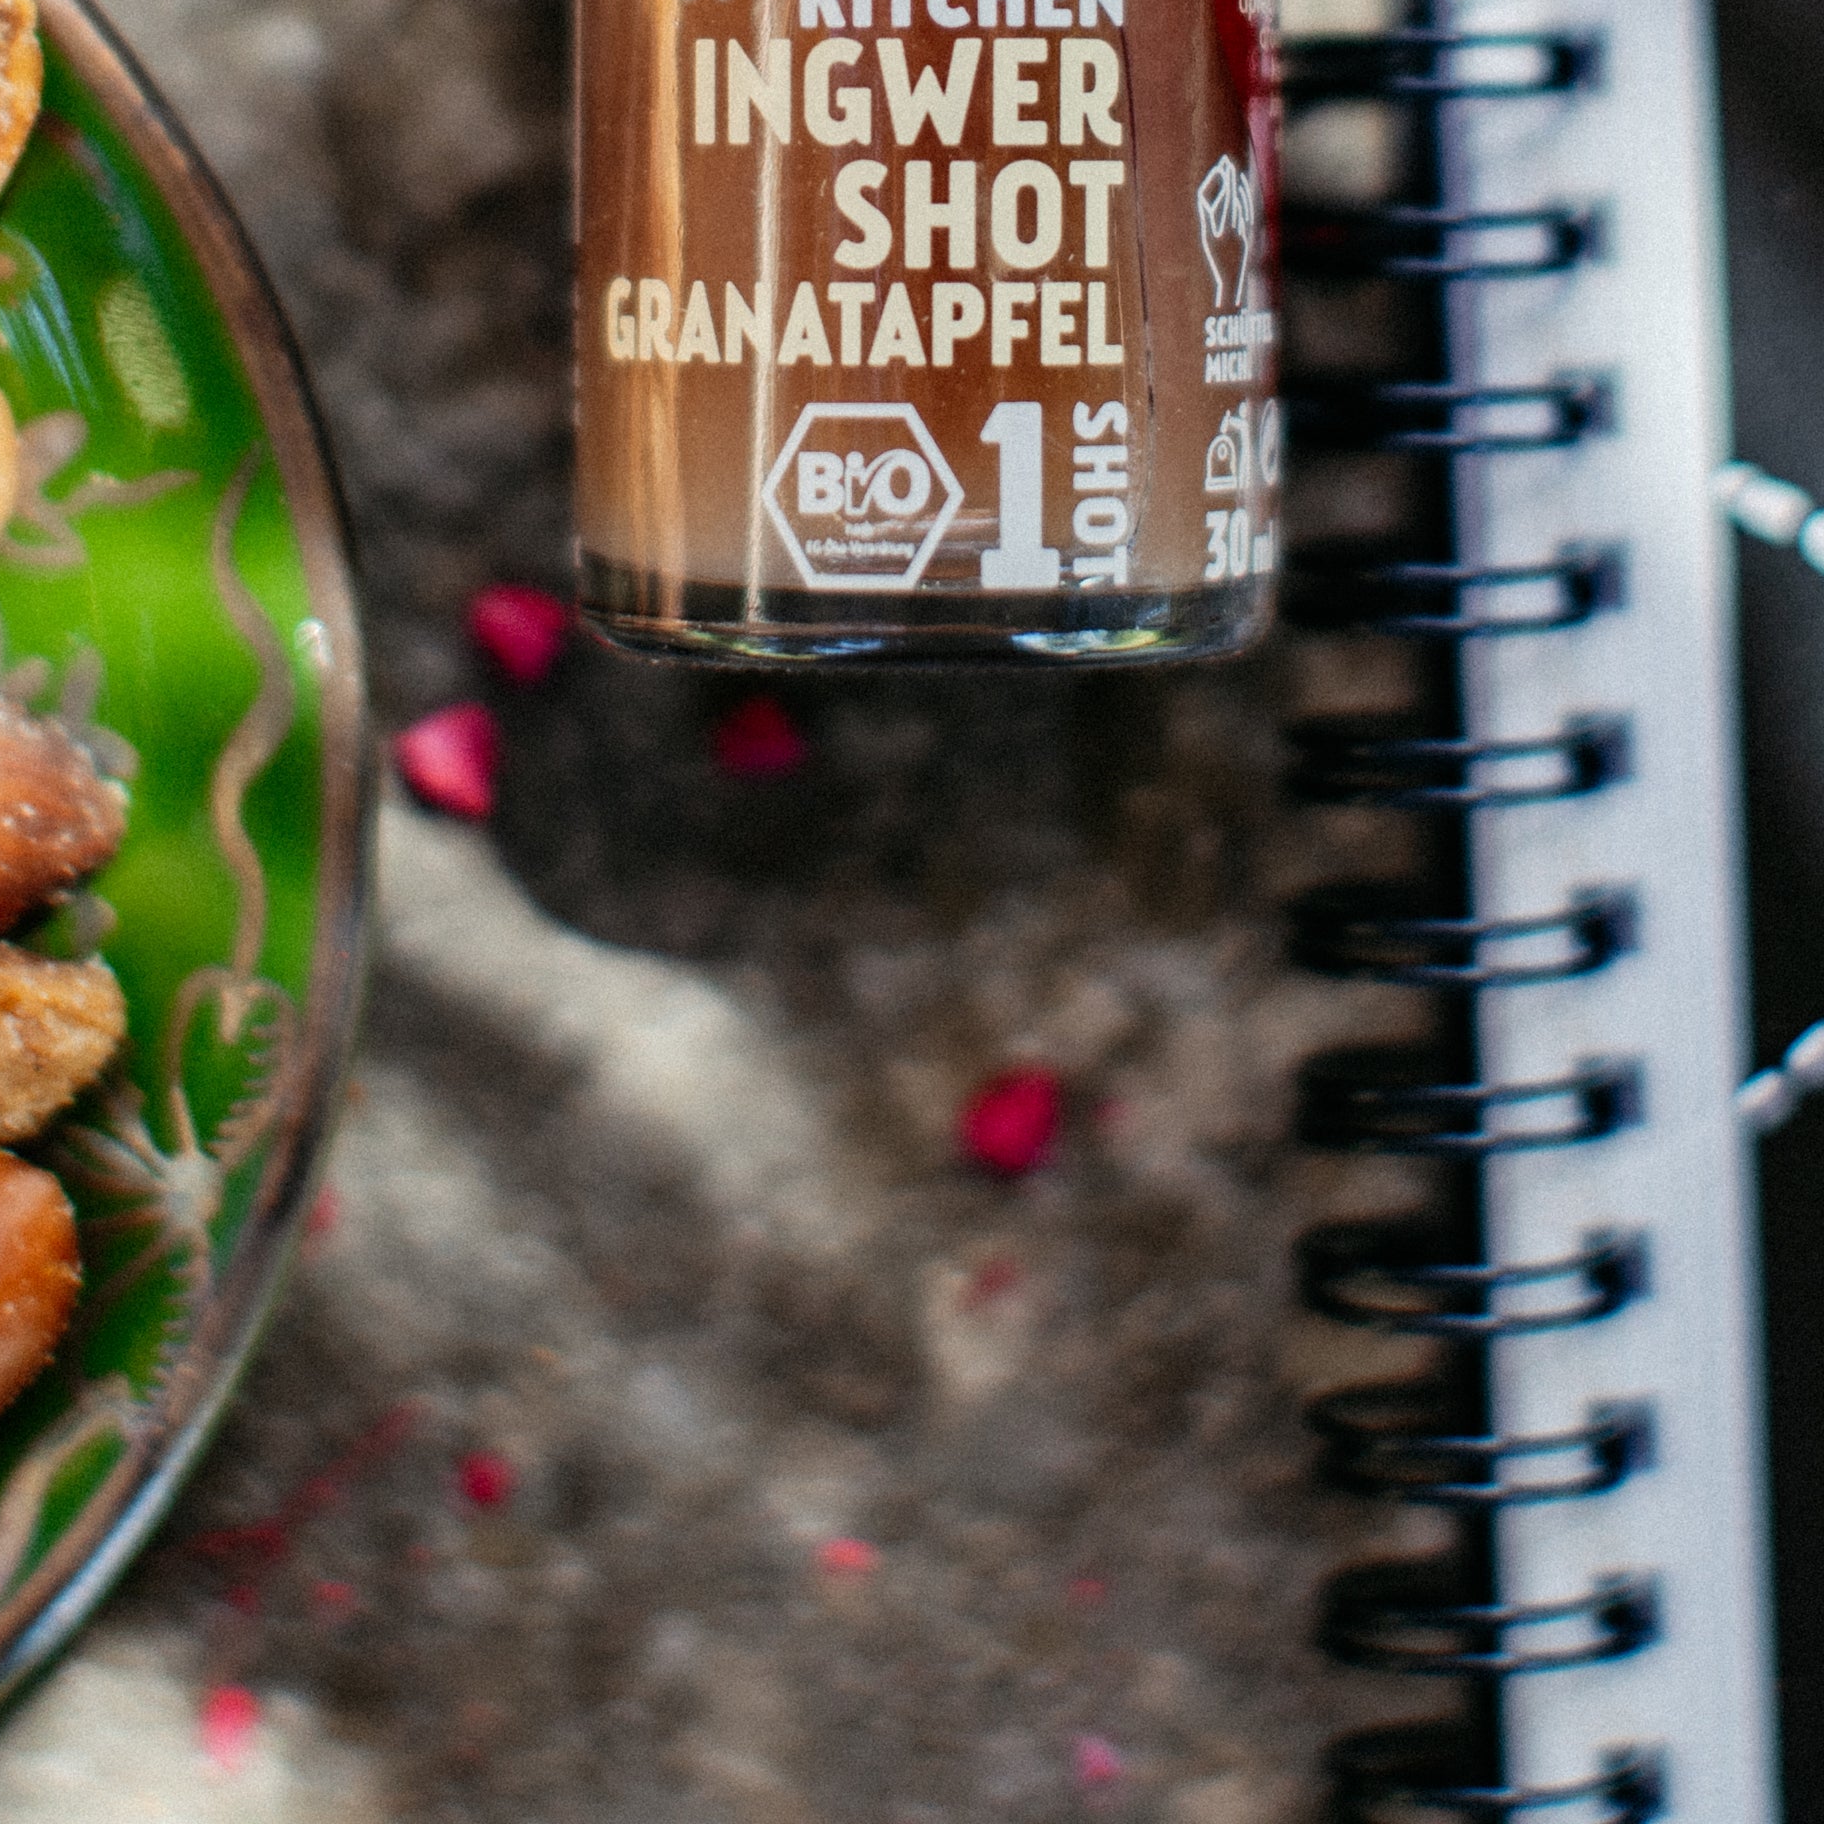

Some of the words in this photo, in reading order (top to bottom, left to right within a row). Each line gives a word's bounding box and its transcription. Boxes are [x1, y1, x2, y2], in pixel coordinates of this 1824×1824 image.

[694, 37, 1124, 147] INGWER
[833, 158, 1126, 271] SHOT
[605, 277, 1125, 367] GRANATAPFEL
[979, 401, 1061, 589] 1
[1073, 400, 1128, 586] SHOT
[1204, 508, 1249, 582] 30
